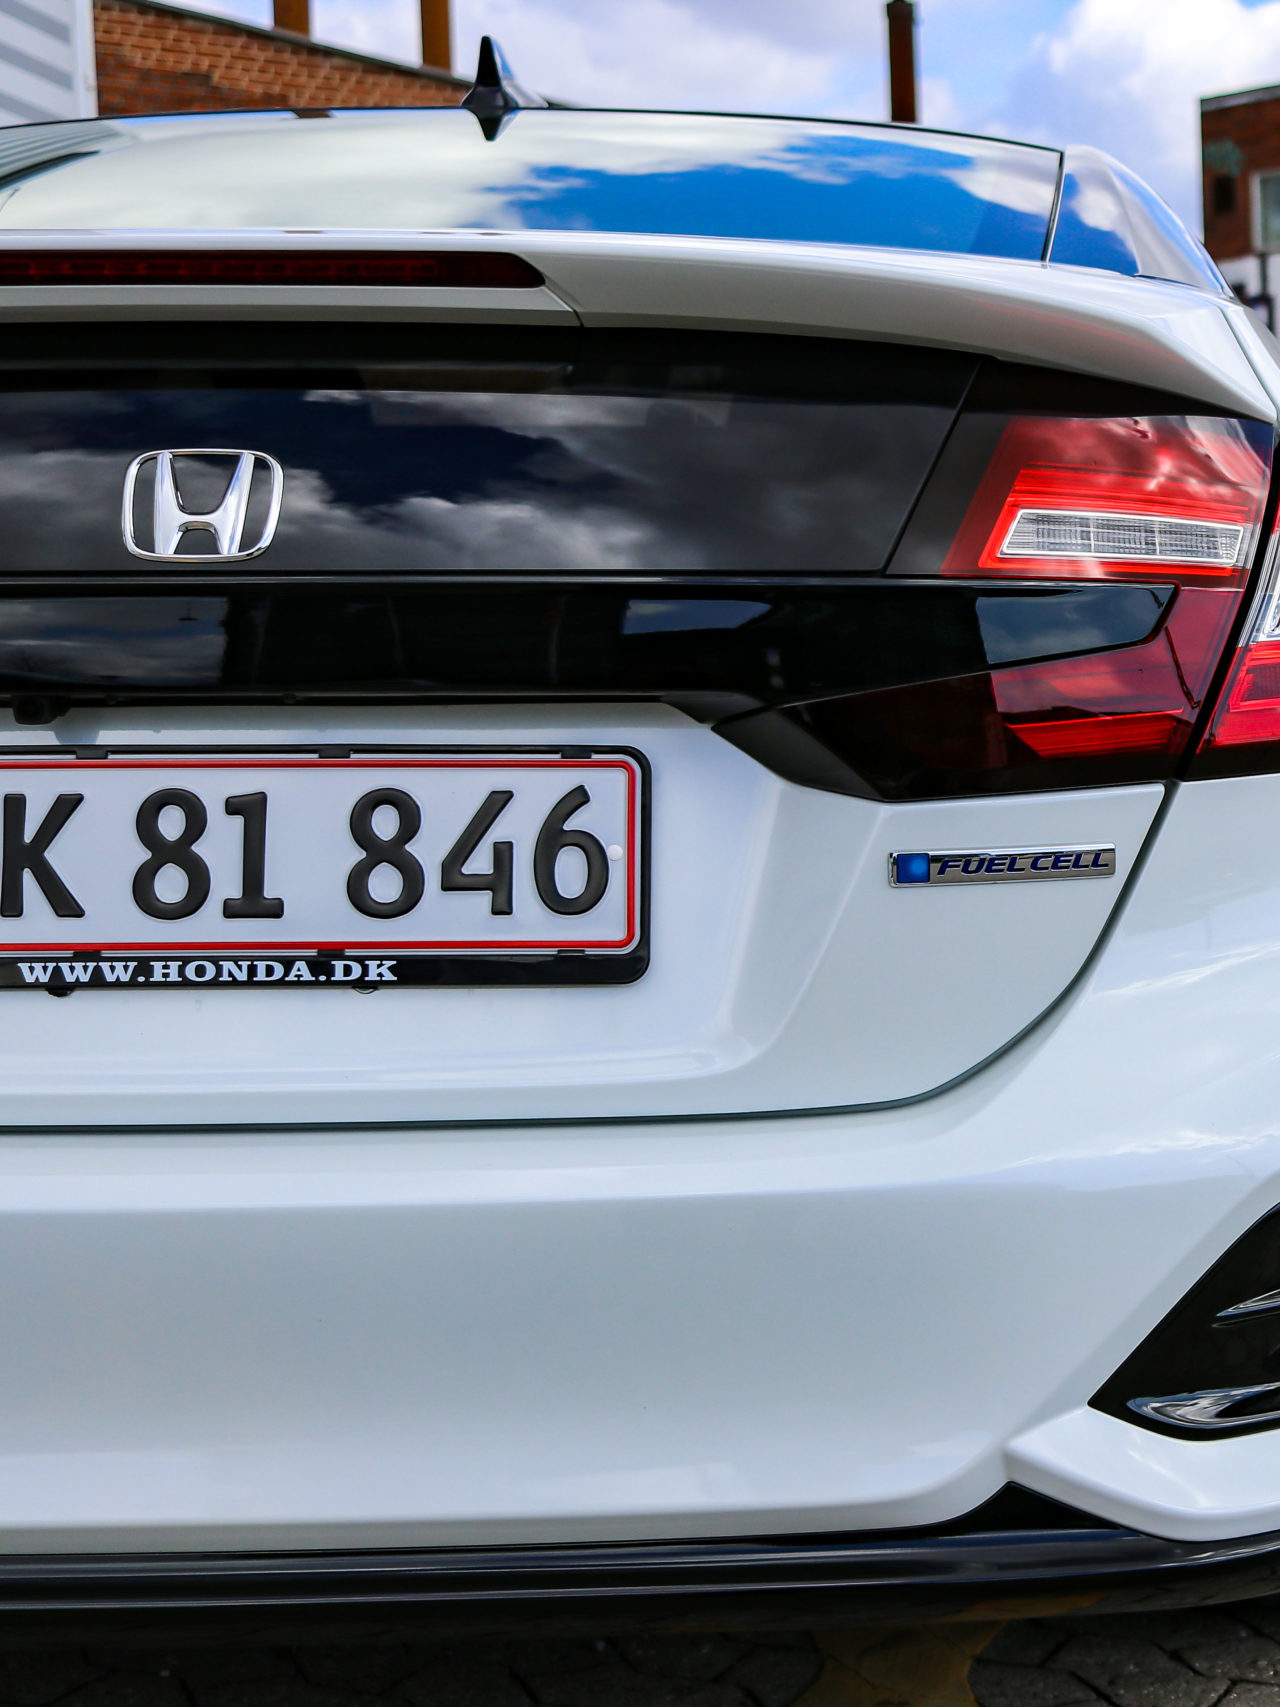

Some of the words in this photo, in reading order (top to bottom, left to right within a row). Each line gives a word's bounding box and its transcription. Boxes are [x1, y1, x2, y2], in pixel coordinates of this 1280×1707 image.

[131, 787, 285, 920] 81
[346, 784, 610, 920] 846
[17, 959, 398, 983] WWW.HONDA.DK
